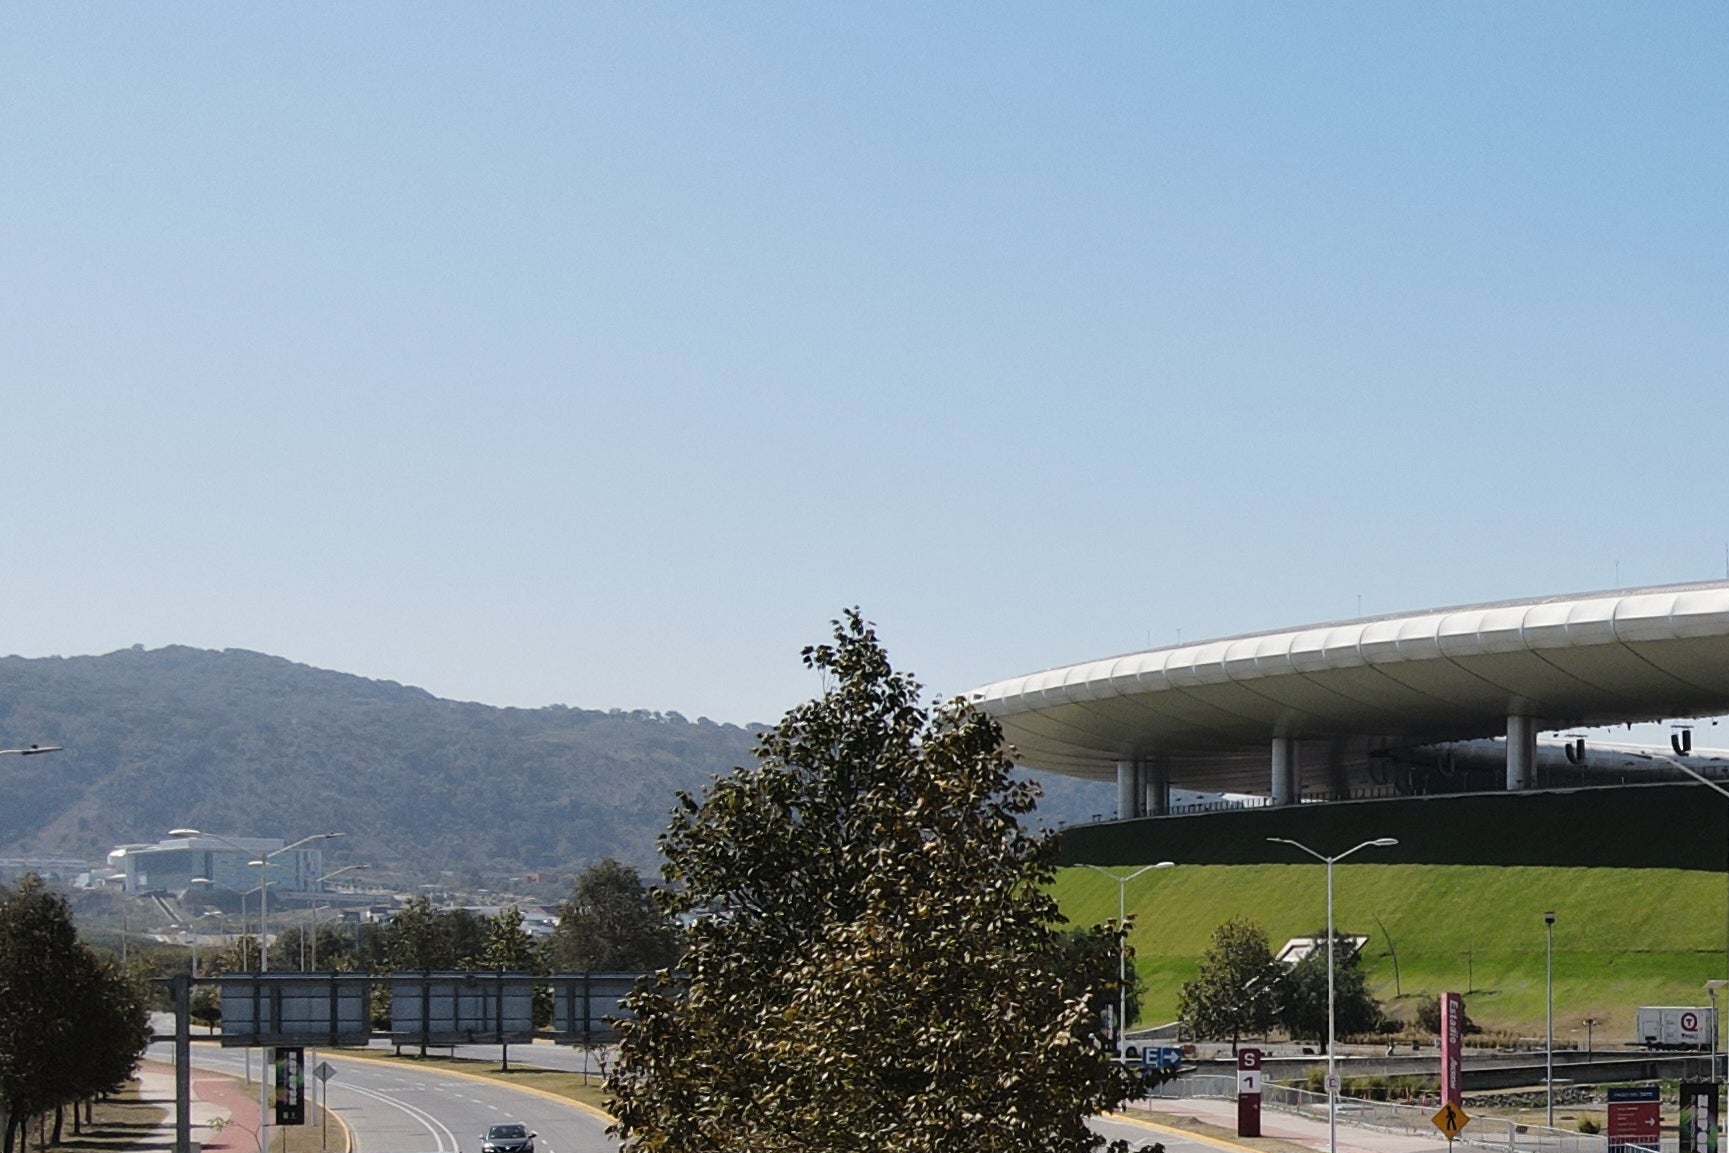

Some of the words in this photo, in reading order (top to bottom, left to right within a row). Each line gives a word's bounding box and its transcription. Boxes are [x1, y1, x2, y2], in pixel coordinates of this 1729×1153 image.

[1449, 1000, 1458, 1044] Estadio
[1146, 1048, 1158, 1064] E
[1244, 1053, 1255, 1066] S
[1243, 1076, 1253, 1088] 1
